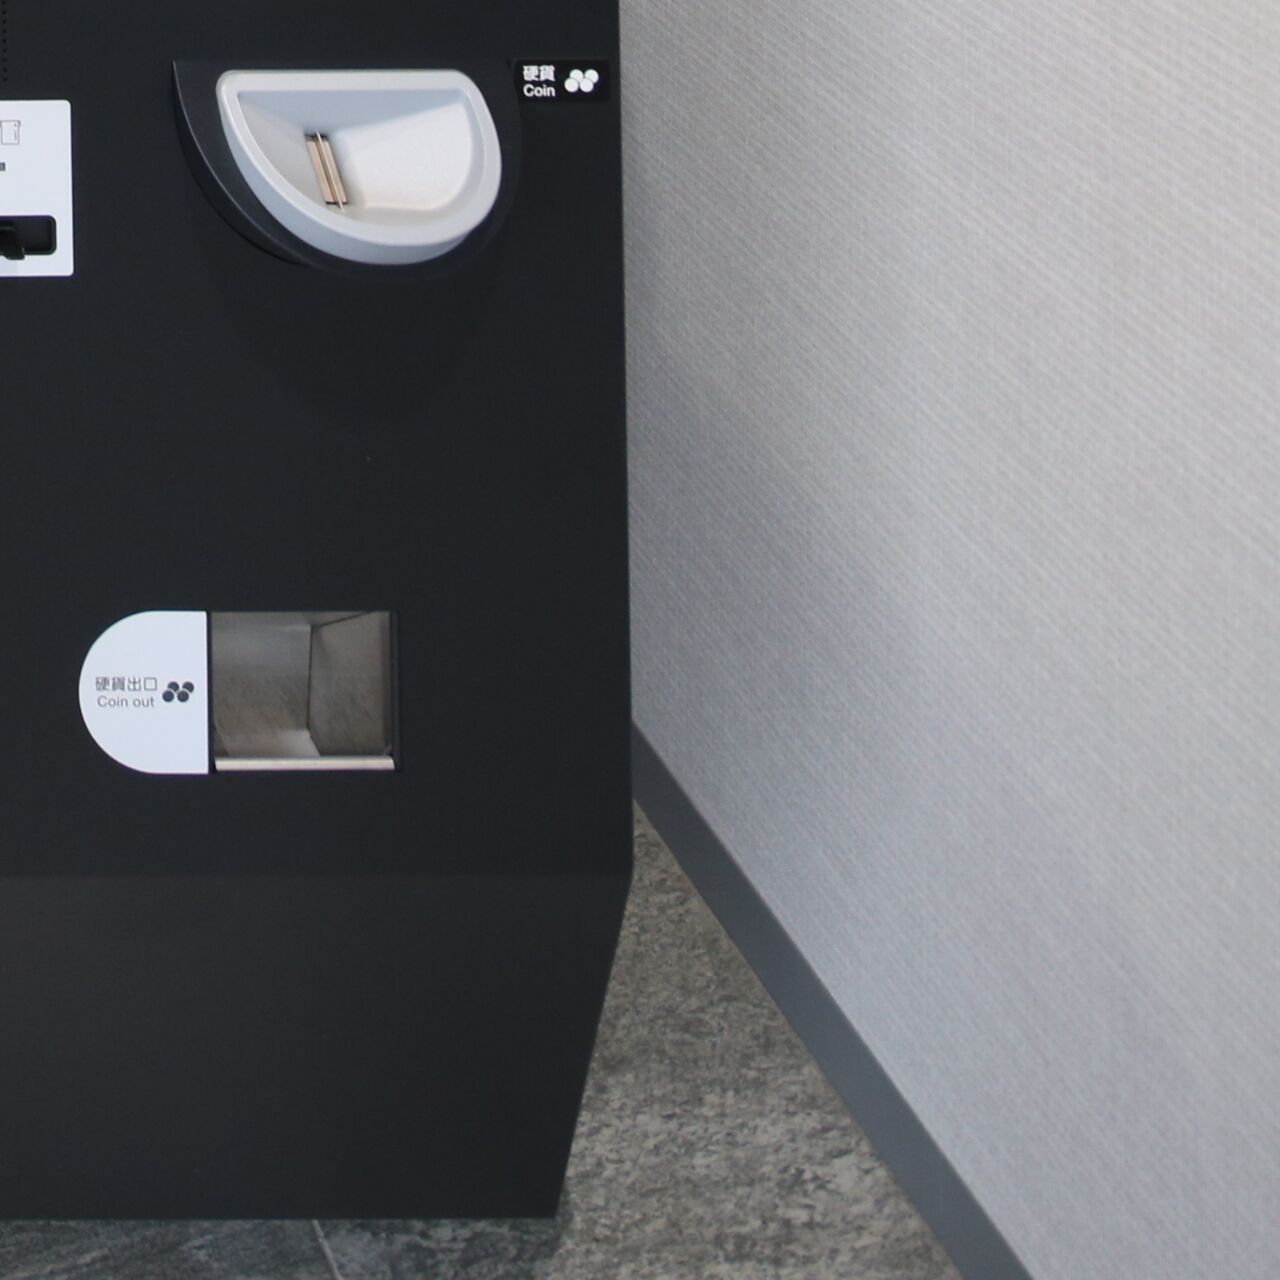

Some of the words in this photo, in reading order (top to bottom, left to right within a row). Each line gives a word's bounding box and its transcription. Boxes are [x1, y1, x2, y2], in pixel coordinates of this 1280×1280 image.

[523, 65, 555, 82] 硬貨
[523, 84, 555, 97] Coin
[95, 677, 157, 691] 硬貨出口
[97, 695, 128, 708] Coin
[132, 697, 155, 708] out
